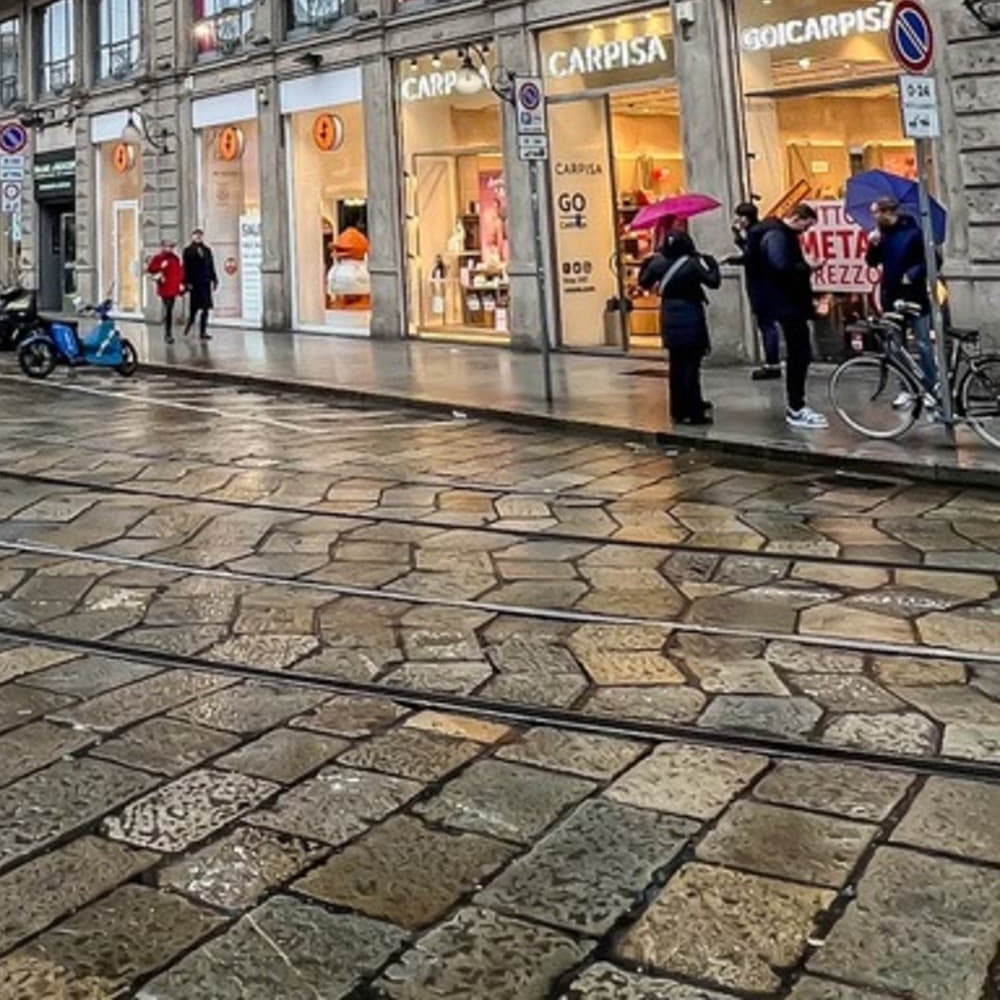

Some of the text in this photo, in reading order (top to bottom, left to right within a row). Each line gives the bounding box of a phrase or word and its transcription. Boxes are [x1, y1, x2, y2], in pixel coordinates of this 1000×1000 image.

[548, 33, 667, 77] CARPISA
[558, 192, 587, 212] GO
[813, 263, 883, 286] REZZO
